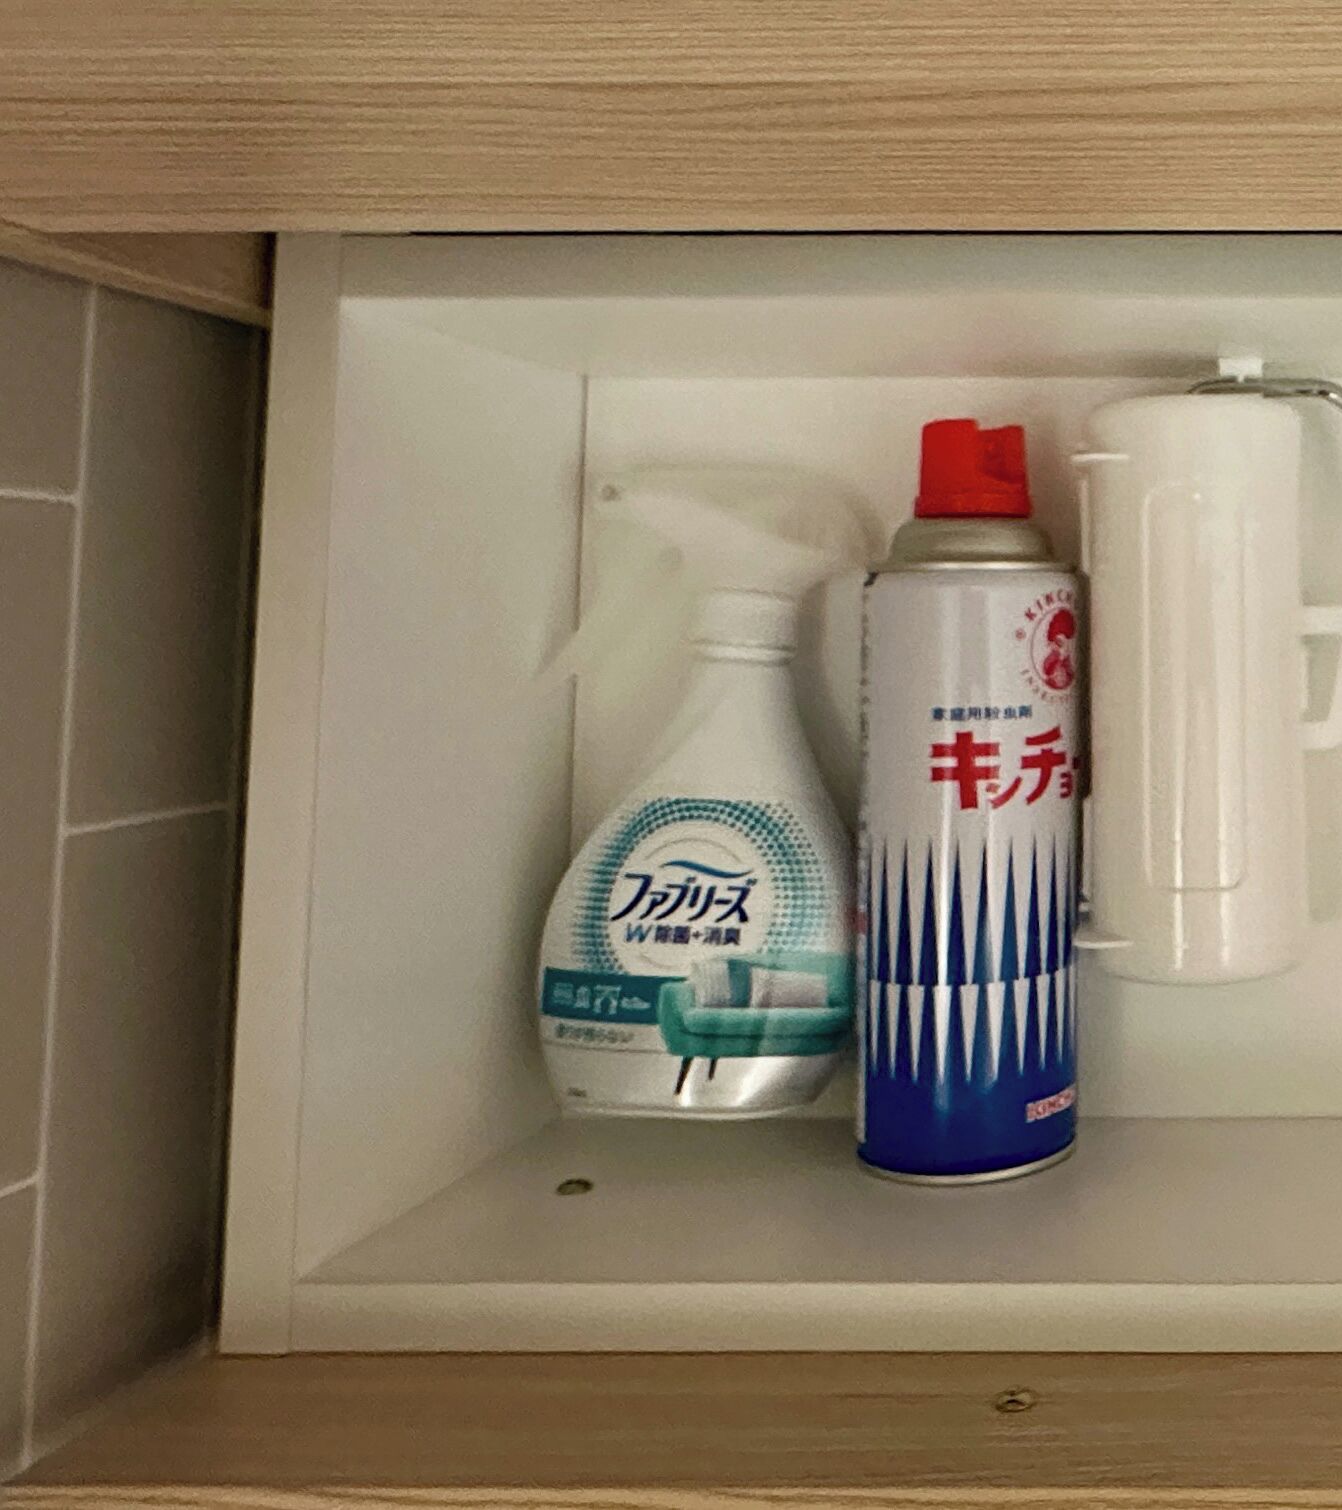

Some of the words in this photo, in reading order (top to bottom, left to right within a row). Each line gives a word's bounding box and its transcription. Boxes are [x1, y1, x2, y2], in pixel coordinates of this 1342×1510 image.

[930, 725, 1080, 810] キンチョ
[610, 872, 758, 923] ファブリーズ
